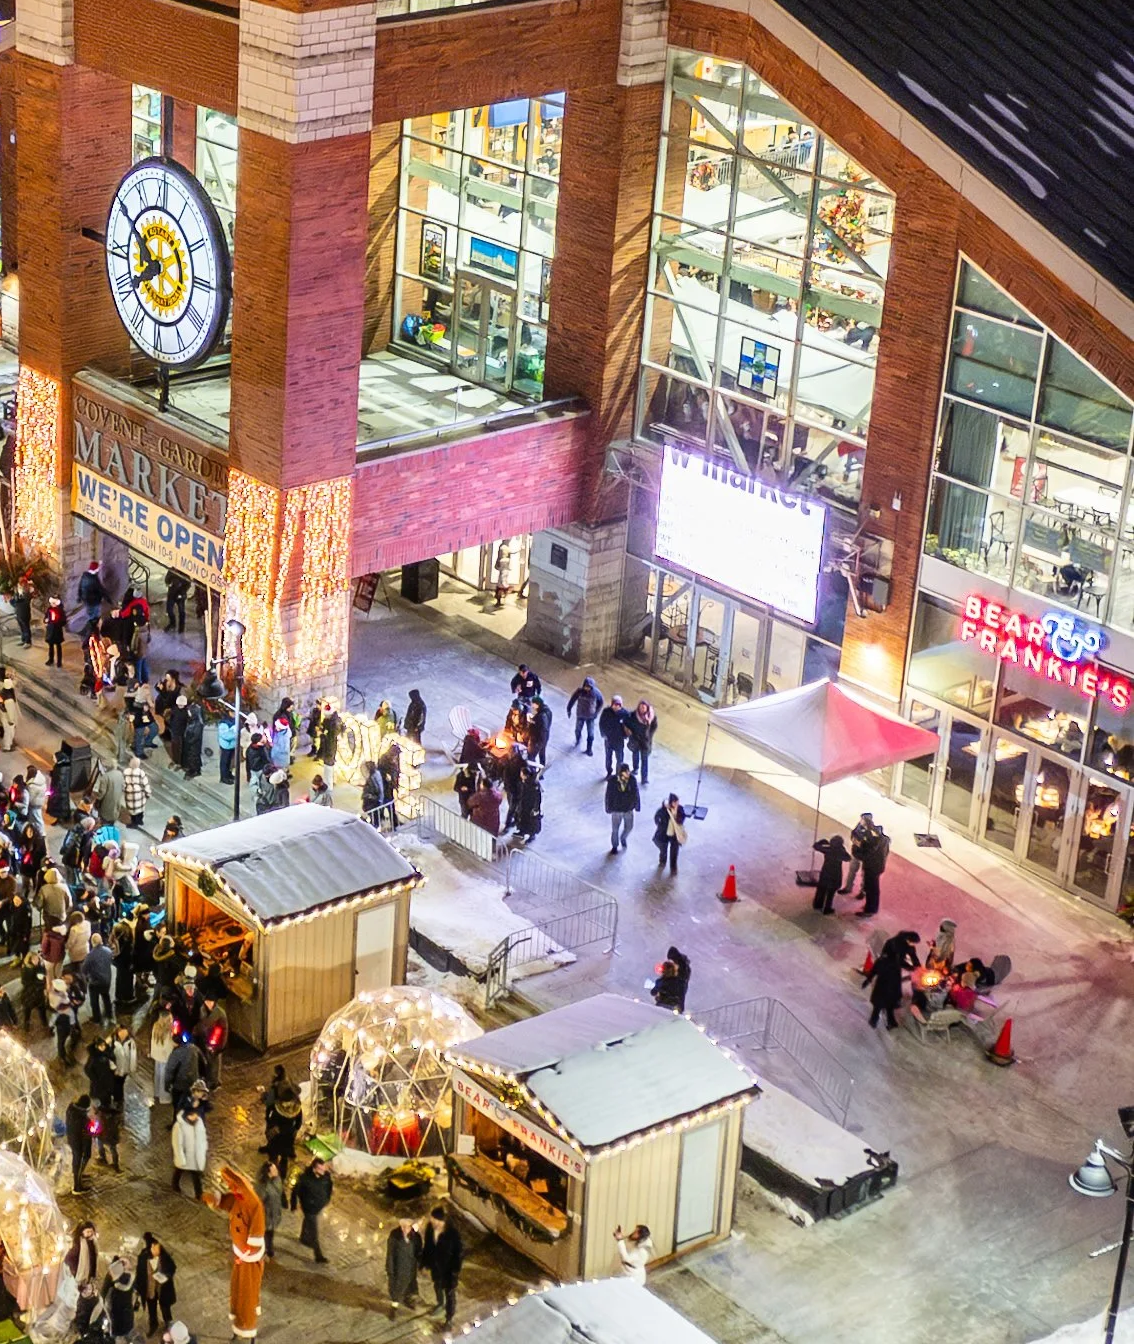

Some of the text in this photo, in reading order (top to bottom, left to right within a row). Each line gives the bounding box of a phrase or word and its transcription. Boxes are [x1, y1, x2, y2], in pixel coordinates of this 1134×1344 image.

[76, 395, 147, 447] COVENT
[74, 419, 227, 534] MARKET
[78, 471, 224, 572] WE'RE OPEN
[78, 499, 96, 518] TUES
[96, 510, 107, 524] TO
[108, 516, 121, 532] SAT
[140, 534, 156, 552] SUN
[158, 544, 173, 561] 10-5
[180, 555, 199, 577] MON
[961, 620, 1129, 708] FRANKIE'S
[965, 595, 1101, 662] BEAR &
[457, 1080, 490, 1110] BEAR
[512, 1119, 582, 1174] FRANKIE'S
